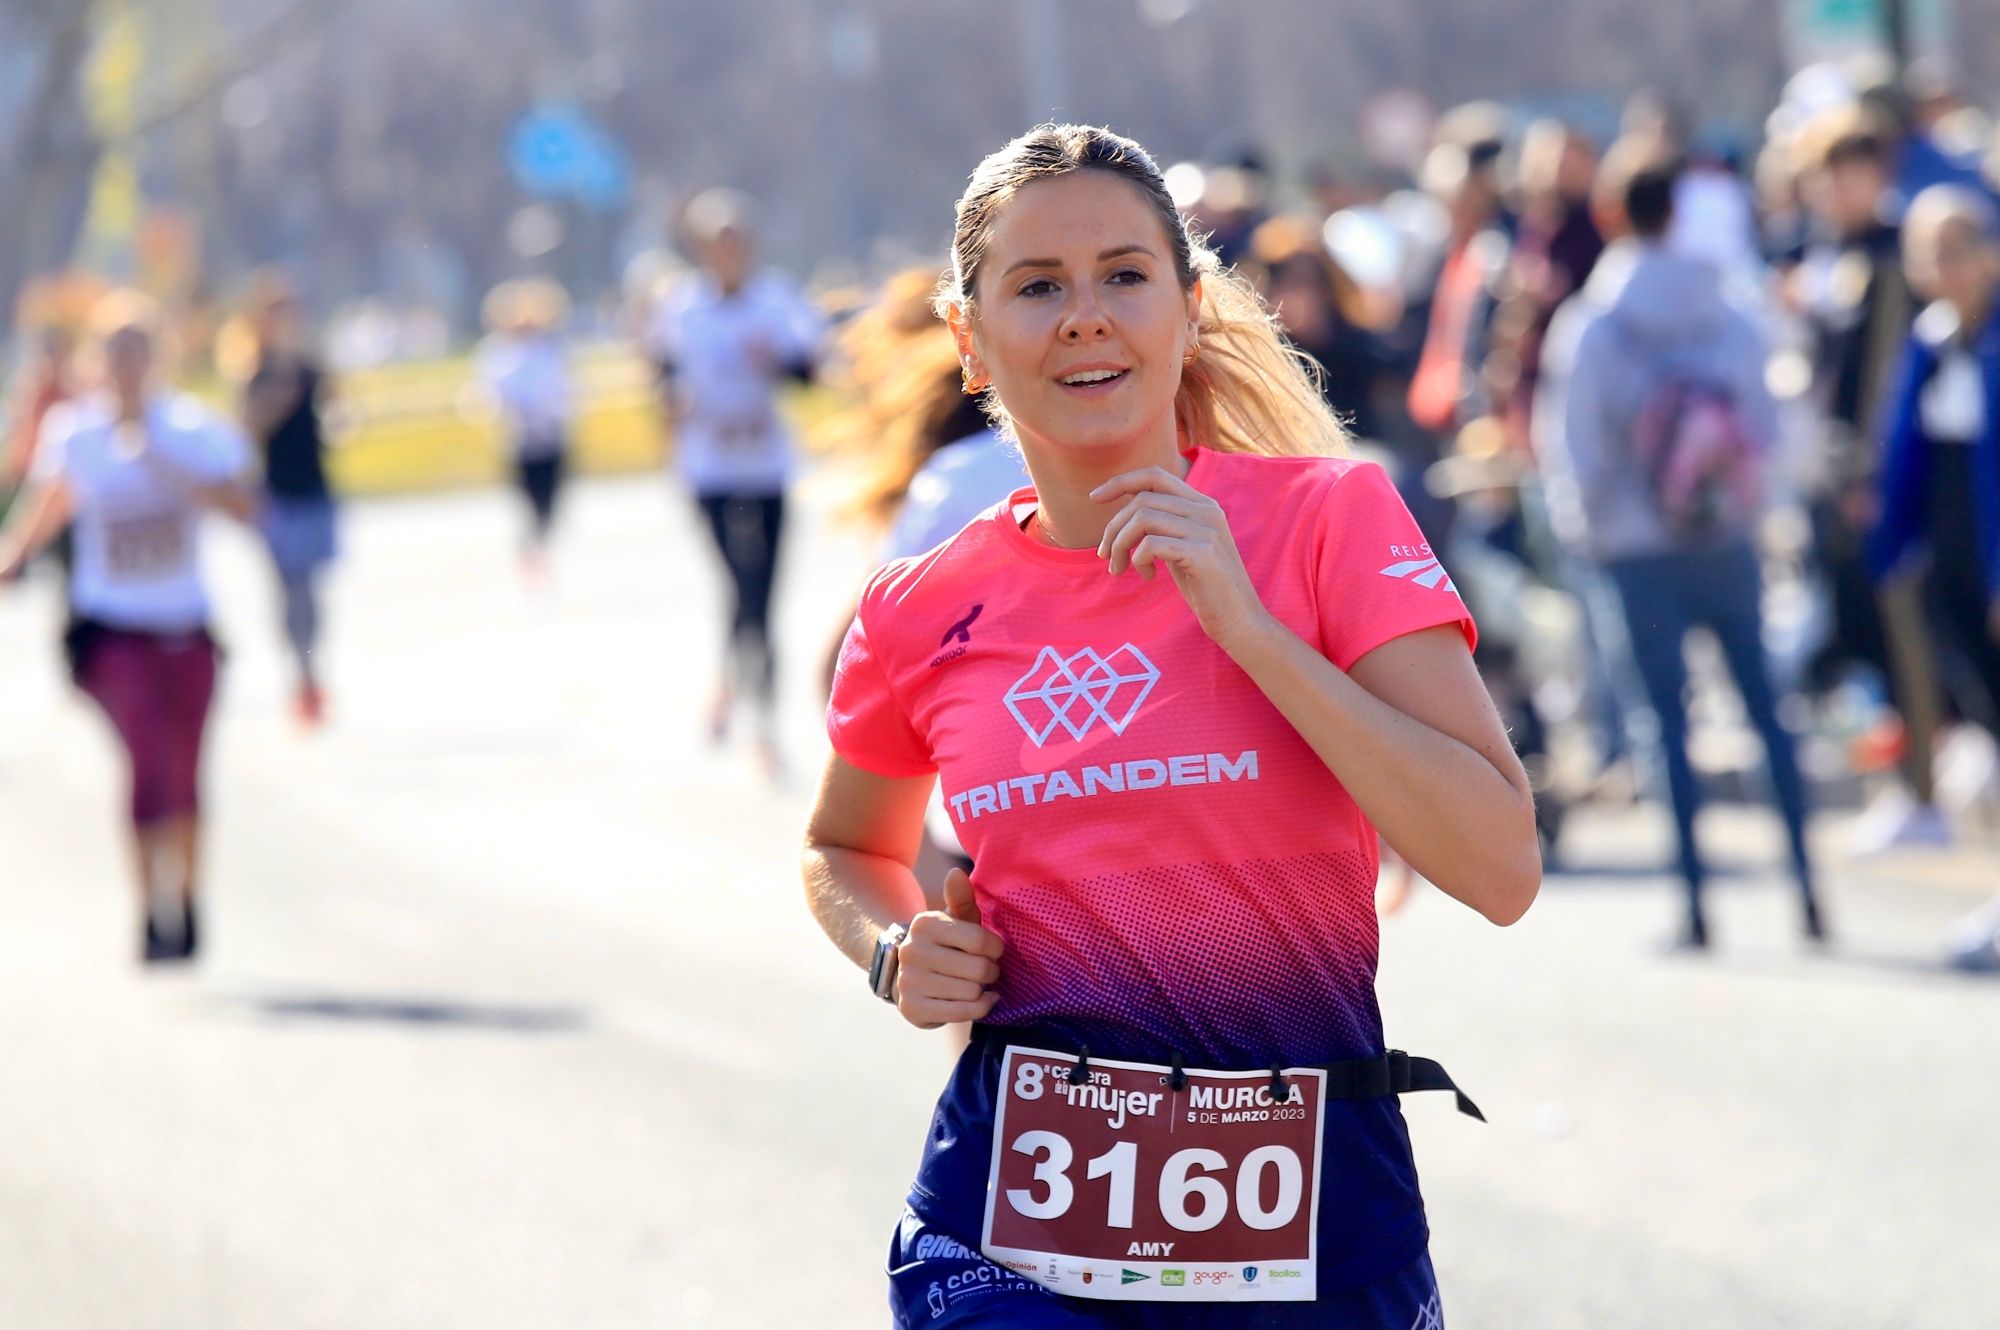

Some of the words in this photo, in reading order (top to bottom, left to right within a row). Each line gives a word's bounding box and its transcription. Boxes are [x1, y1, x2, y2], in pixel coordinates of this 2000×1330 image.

[950, 750, 1258, 823] TRITANDEM
[1051, 1065, 1112, 1087] caera
[1068, 1083, 1163, 1130] mujer
[1188, 1083, 1304, 1110] MURCA
[1187, 1111, 1196, 1123] 5
[1200, 1112, 1218, 1124] DE
[1221, 1110, 1269, 1123] MARZO
[1272, 1108, 1305, 1121] 2023
[1005, 1130, 1303, 1232] 3160
[1127, 1242, 1175, 1256] AMY
